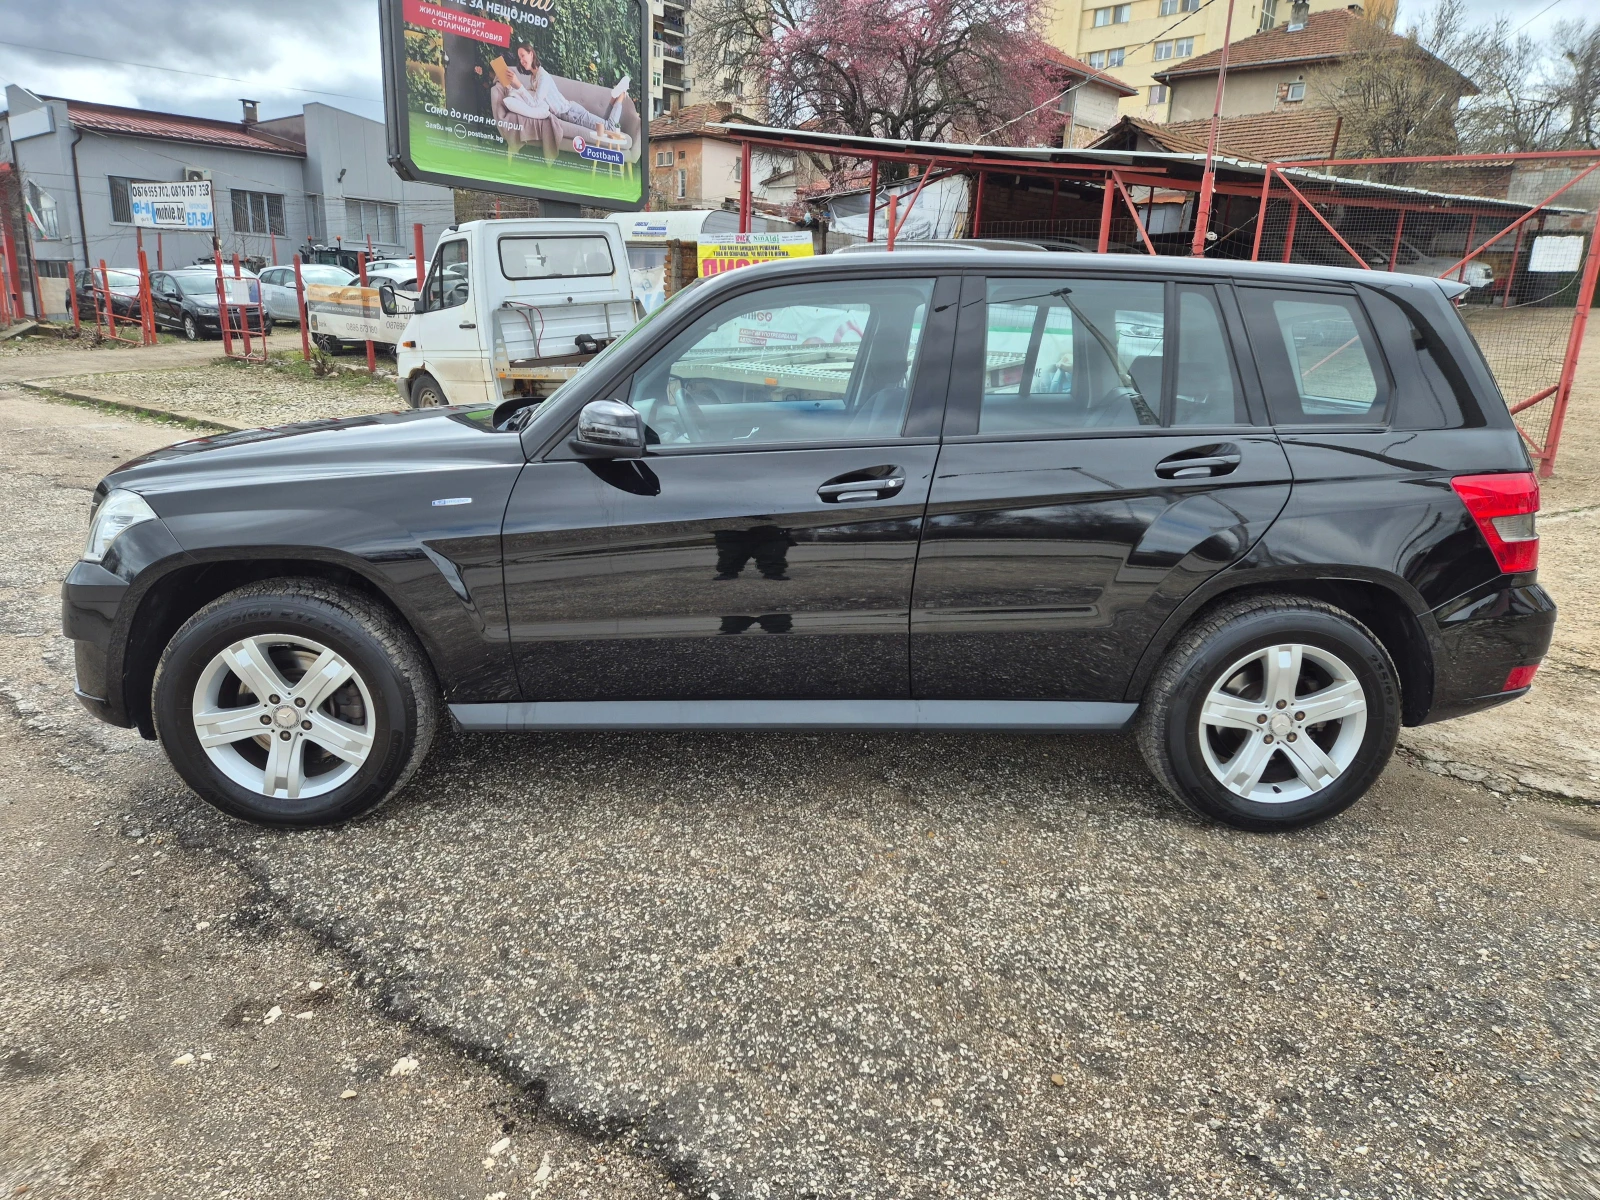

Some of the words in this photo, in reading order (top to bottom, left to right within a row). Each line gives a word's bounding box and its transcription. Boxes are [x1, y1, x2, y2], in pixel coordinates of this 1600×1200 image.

[419, 5, 457, 22] ЖИЛИЩЕН
[458, 14, 486, 29] КРЕДИТ
[469, 0, 484, 10] ЗА
[486, 3, 518, 19] НЕЩО
[520, 11, 549, 28] НОВО
[438, 20, 471, 34] ОТЛИЧНИ
[471, 27, 503, 42] УСЛОВИЯ
[424, 103, 449, 116] Само
[450, 107, 462, 119] до
[463, 112, 484, 124] края
[485, 118, 496, 126] на
[498, 119, 524, 131] април
[425, 121, 444, 130] Заяви
[467, 130, 504, 144] postbank.bg
[586, 148, 621, 162] Postbank
[132, 186, 149, 197] 0876
[155, 205, 185, 222] mobile.bg
